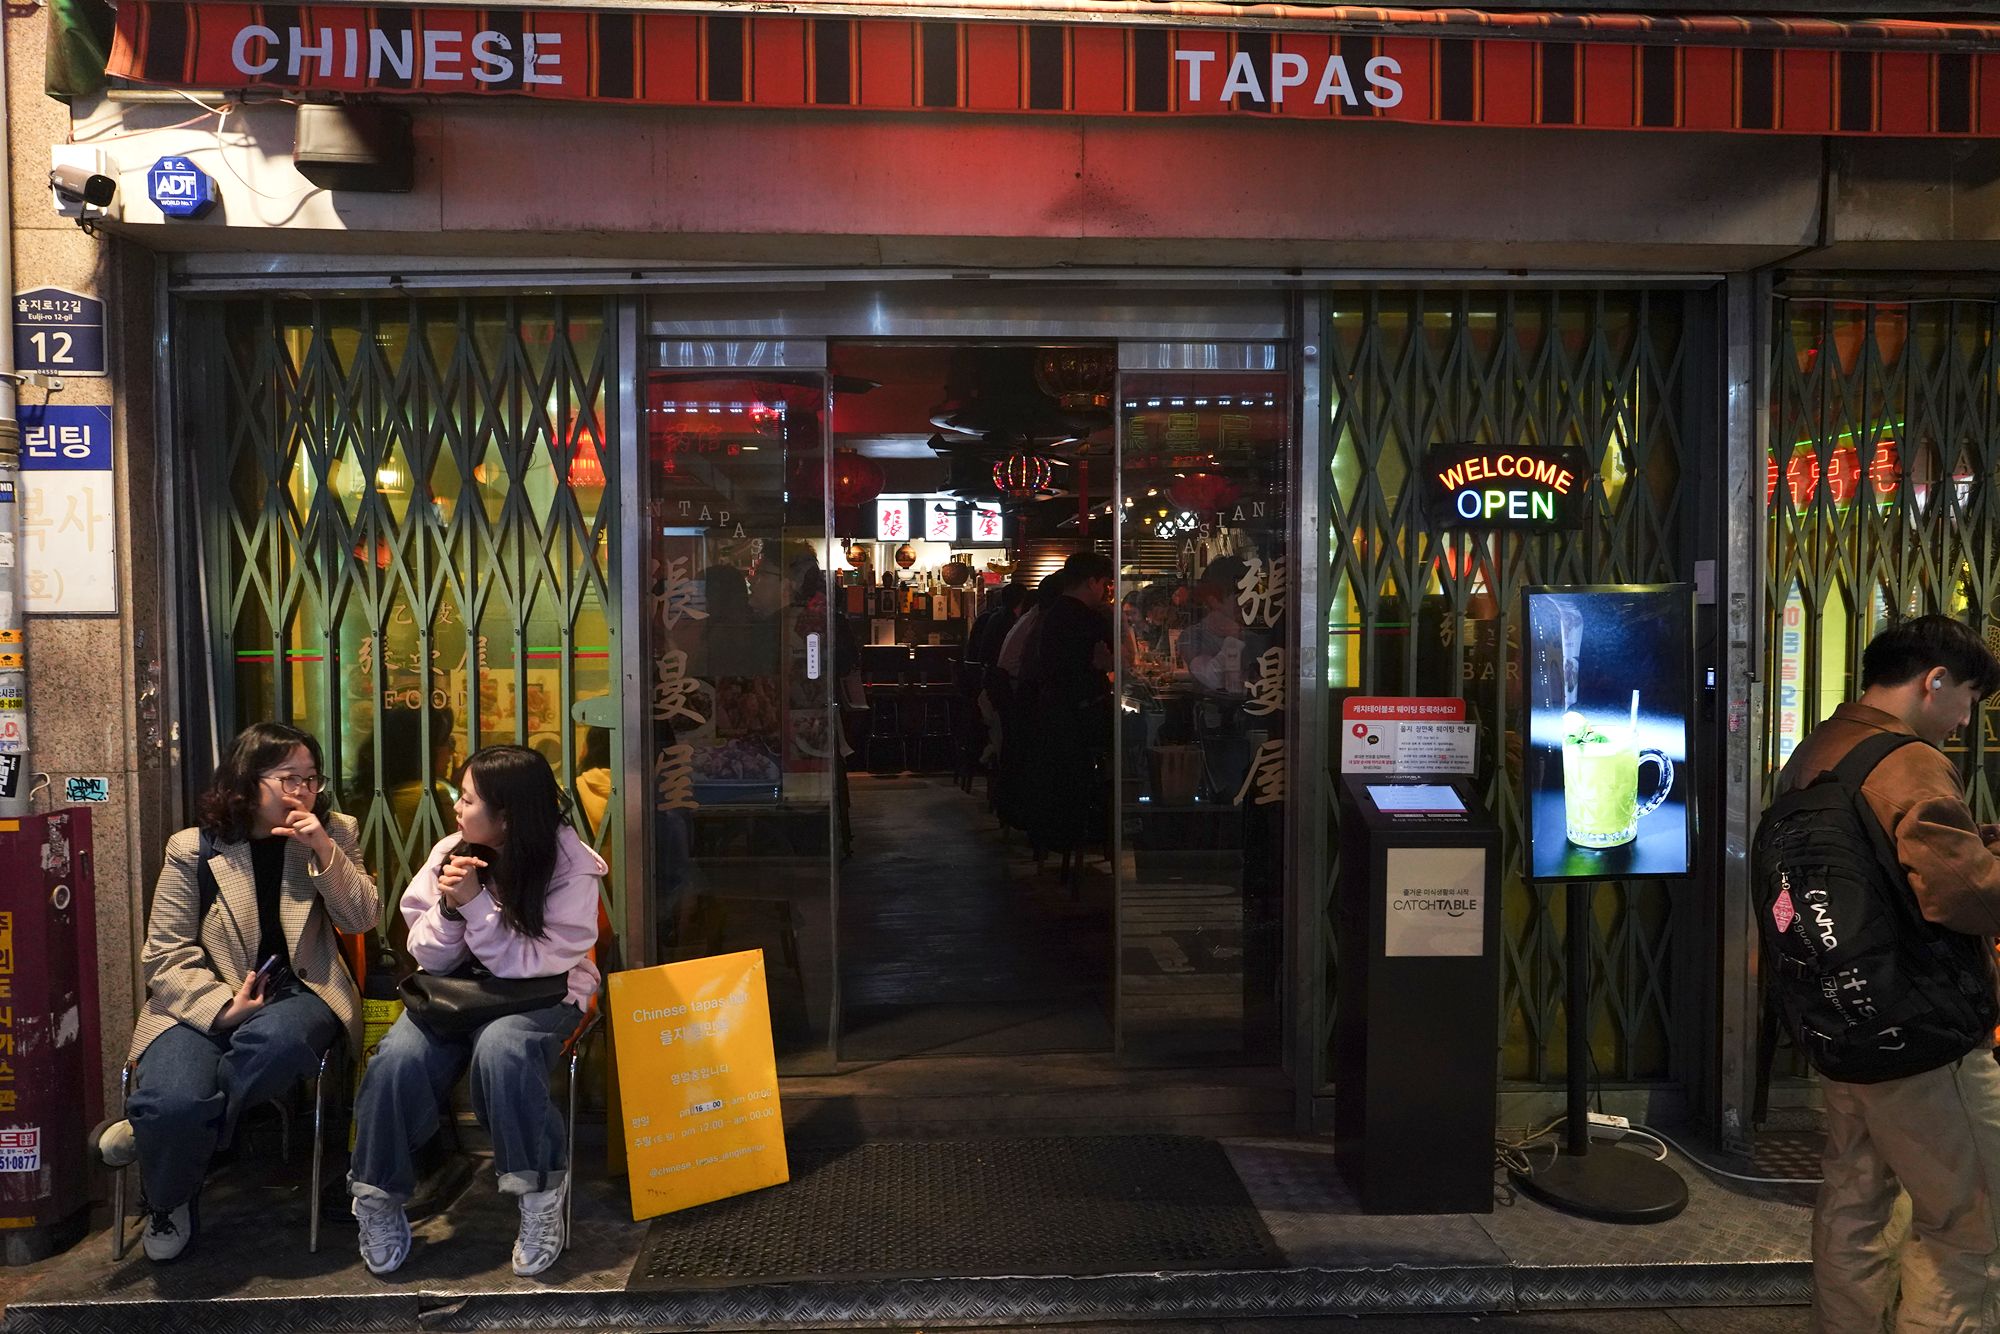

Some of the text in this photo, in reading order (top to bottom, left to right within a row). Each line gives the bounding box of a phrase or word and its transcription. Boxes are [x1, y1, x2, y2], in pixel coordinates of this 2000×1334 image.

[231, 24, 1403, 109] CHINESE TAPAS
[157, 175, 192, 195] ADT
[18, 299, 82, 313] 을지로12길
[28, 313, 73, 321] Eulji-ro 12-gil
[30, 332, 74, 363] 12
[20, 425, 91, 458] 린팅
[1438, 454, 1576, 495] WELCOME
[1457, 489, 1554, 520] OPEN
[679, 500, 763, 555] TAPAS
[1183, 502, 1265, 555] ASIAN
[1397, 704, 1418, 714] 웨이팅
[1393, 900, 1477, 910] CATCHTABLE
[632, 1004, 687, 1023] Chinese
[691, 998, 724, 1013] tapas
